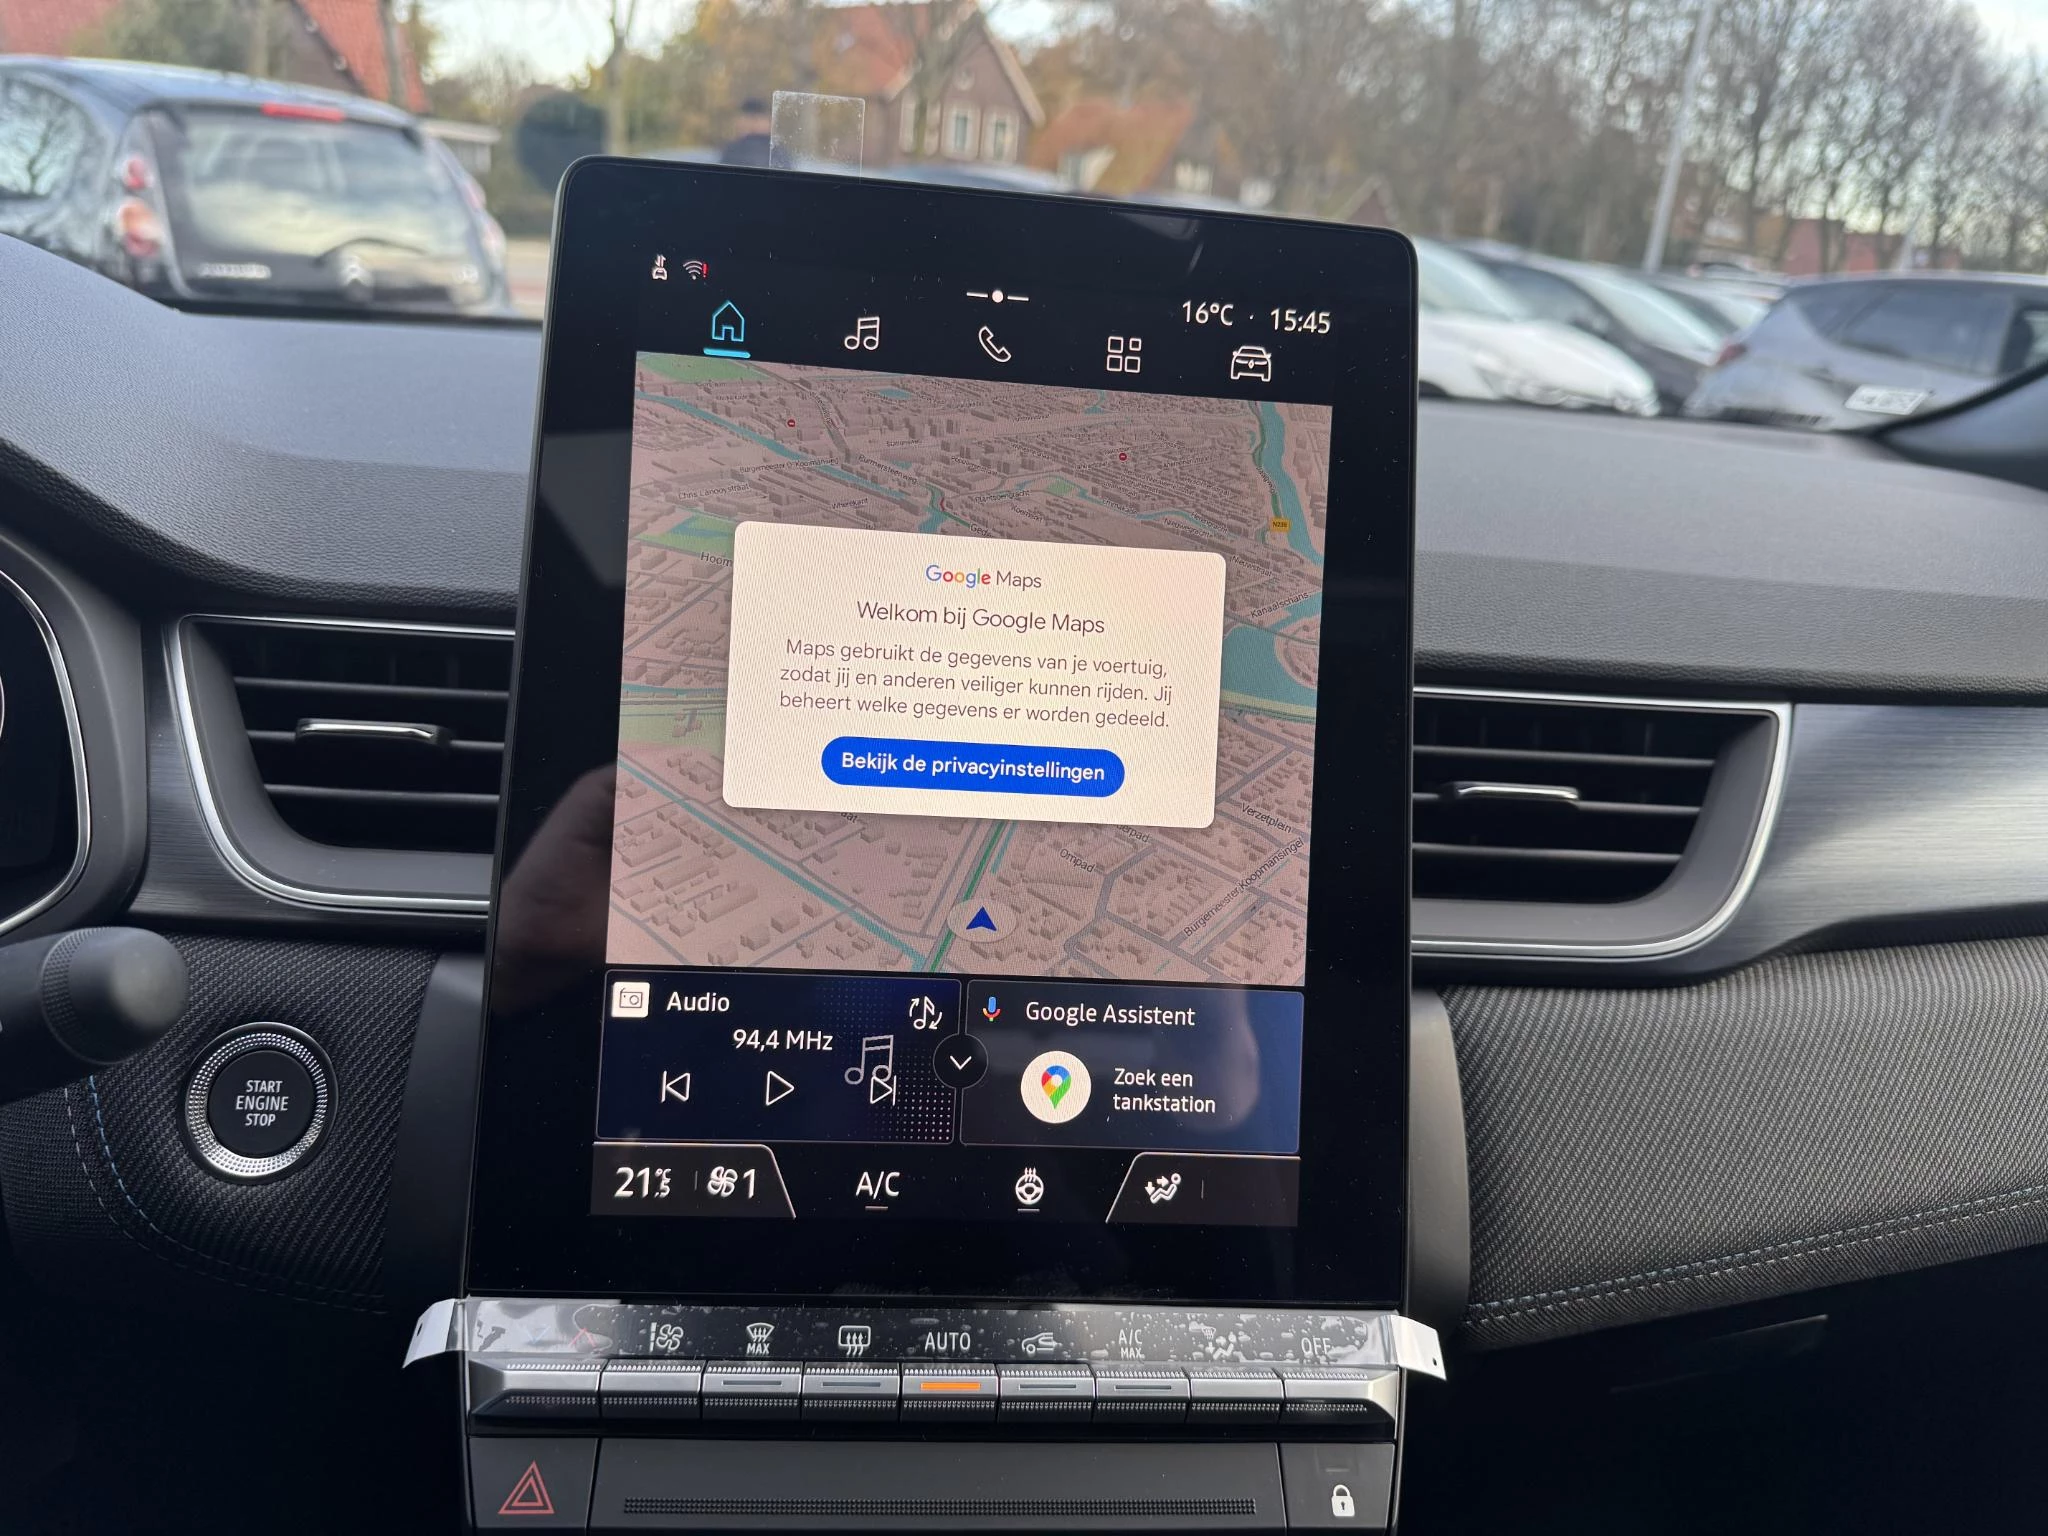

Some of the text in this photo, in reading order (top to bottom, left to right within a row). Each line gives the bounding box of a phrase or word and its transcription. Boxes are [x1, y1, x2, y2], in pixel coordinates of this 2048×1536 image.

[1182, 300, 1234, 326] 16°C
[1270, 308, 1331, 334] 15:45
[926, 564, 1042, 591] Google Maps
[857, 600, 1105, 637] Welkom bij Google Maps
[786, 639, 1167, 680] Maps gebruikt de gegevens van je voertuig,
[780, 666, 1173, 706] zodat jij en anderen veiliger kunnen rijden. Jij
[780, 690, 1169, 729] beheert welke gegevens er worden gedeeld.
[841, 752, 1105, 784] Bekijk de privacyinstellingen
[1240, 802, 1293, 834] Verzetplein
[1059, 848, 1096, 874] Ompad
[1183, 837, 1305, 937] Burgemeester Koopmansingel
[666, 991, 730, 1012] Audio
[1025, 1001, 1196, 1027] Google Assistent
[732, 1028, 834, 1052] 94,4 MHz
[246, 1079, 283, 1093] START
[1113, 1067, 1193, 1088] Zoek een
[235, 1095, 289, 1112] ENGINE
[1112, 1093, 1216, 1114] tankstation
[245, 1113, 276, 1127] STOP
[855, 1171, 900, 1199] A/C
[746, 1342, 770, 1355] MAX
[924, 1331, 971, 1352] AUTO
[1118, 1328, 1143, 1345] A/C
[1301, 1337, 1331, 1354] OFF
[1120, 1347, 1142, 1359] MAX
